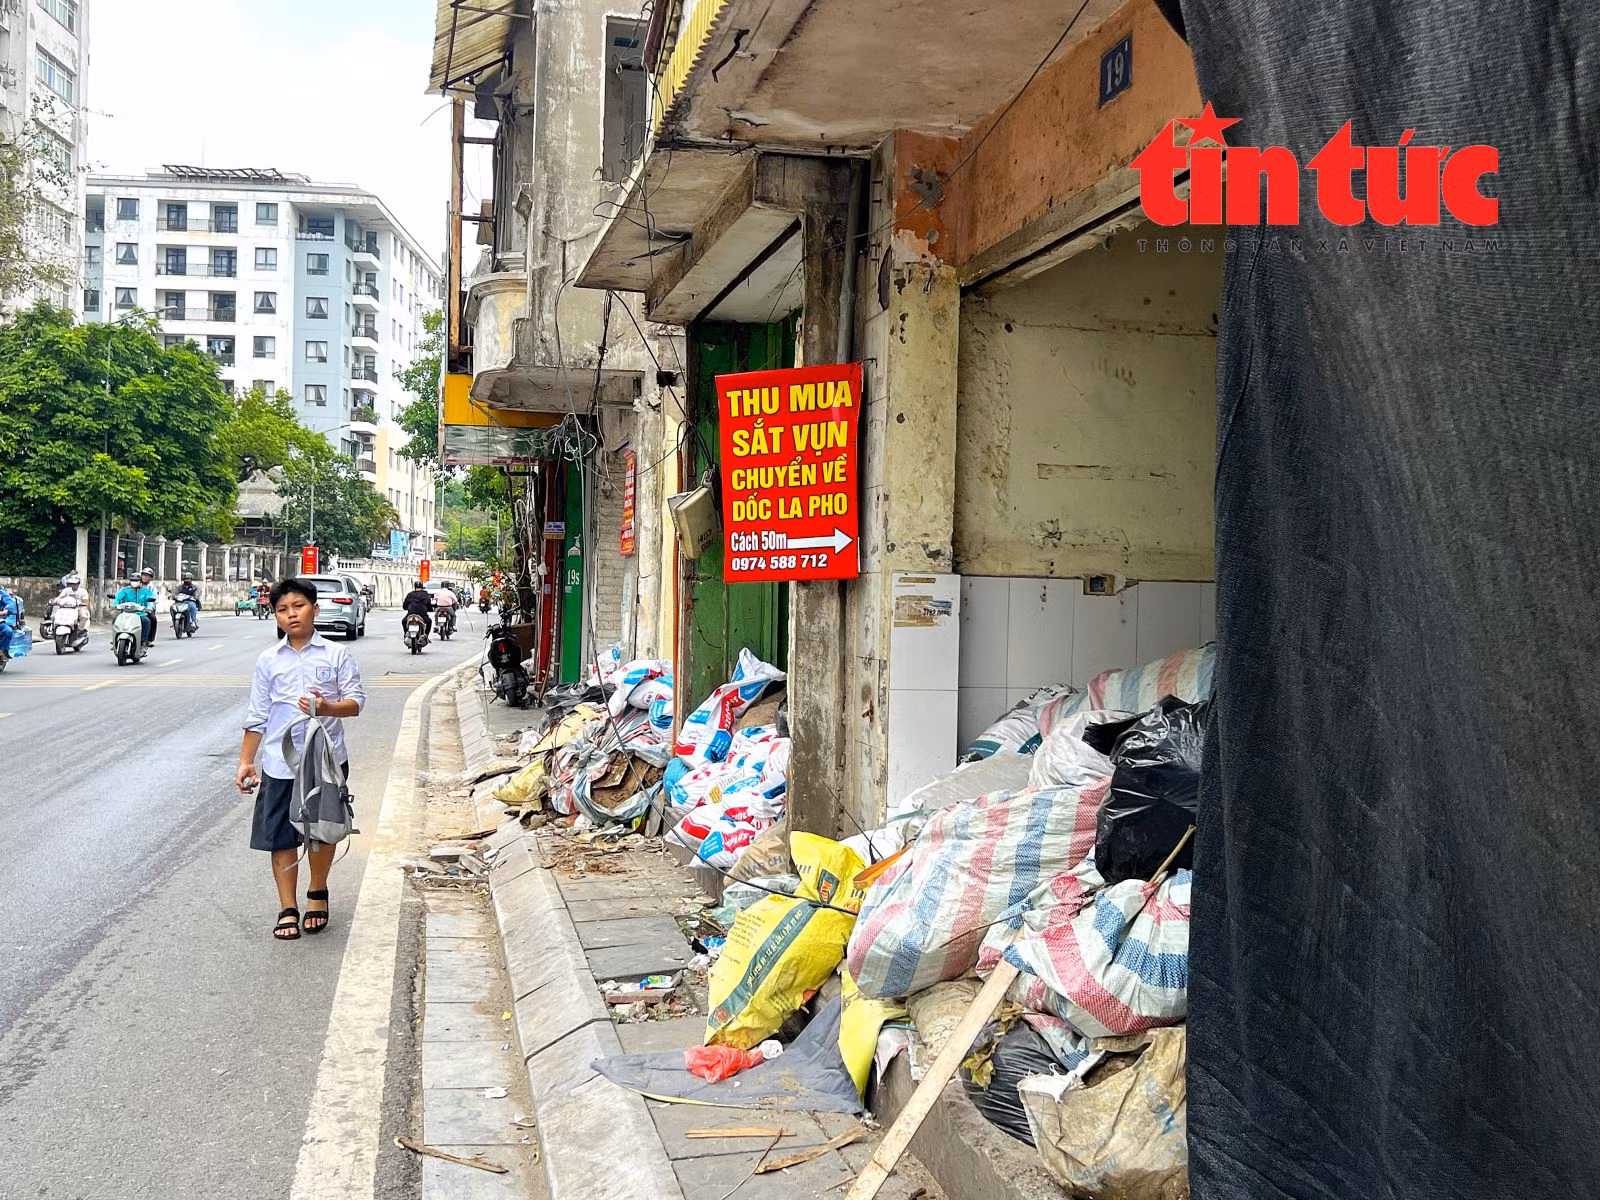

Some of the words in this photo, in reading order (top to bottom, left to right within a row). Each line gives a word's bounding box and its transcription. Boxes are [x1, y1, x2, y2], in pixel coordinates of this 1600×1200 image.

[726, 386, 780, 417] THU
[790, 380, 853, 412] MUA
[732, 418, 784, 457] SẮT
[792, 421, 848, 457] VỤN
[732, 456, 817, 491] CHUYỂN
[822, 453, 848, 483] VỀ
[732, 492, 772, 522] DỐC
[778, 497, 803, 520] LA
[808, 492, 848, 517] PHO
[731, 531, 759, 552] Cách
[761, 530, 788, 551] 50m
[731, 556, 766, 571] 0974
[770, 555, 797, 569] 588
[801, 553, 828, 569] 712
